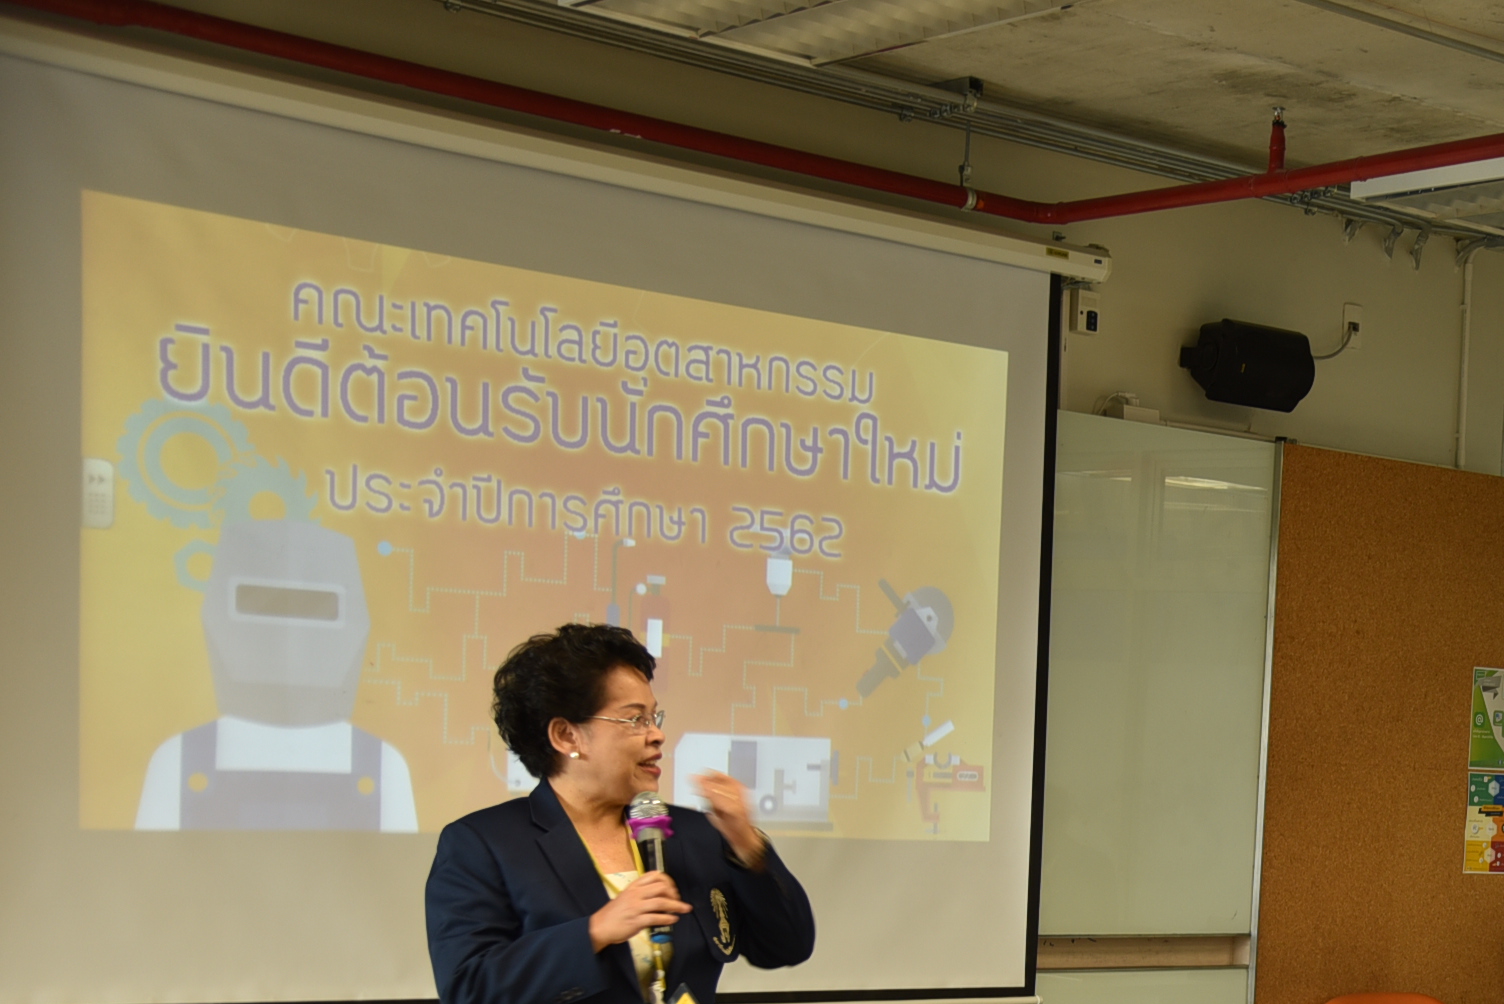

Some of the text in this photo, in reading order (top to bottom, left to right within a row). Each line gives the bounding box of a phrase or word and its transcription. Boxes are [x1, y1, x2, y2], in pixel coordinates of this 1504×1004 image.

[291, 280, 876, 405] คณะเทคโนโลยีอุตสาหกรรม
[157, 322, 963, 496] ยินดีต้อนรับนักศึกษาใหม่
[324, 463, 845, 559] ประจำปีการศึกษา 2562
